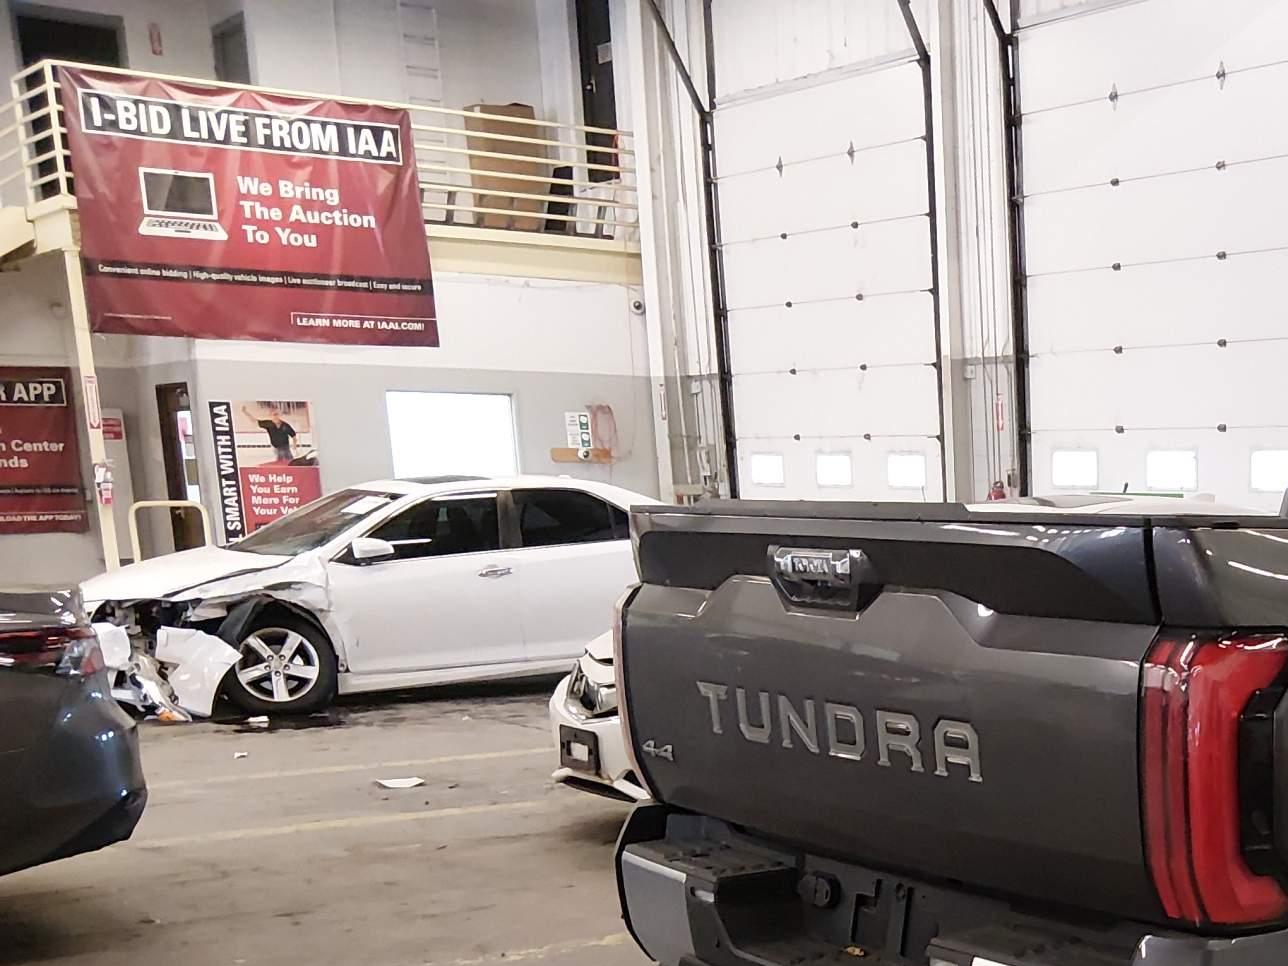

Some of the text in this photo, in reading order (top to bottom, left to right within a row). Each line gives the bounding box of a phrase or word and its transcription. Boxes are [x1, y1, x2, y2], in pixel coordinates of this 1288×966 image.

[90, 97, 397, 158] I-BID LIVE FROM IAA
[236, 175, 340, 206] We Bring
[239, 200, 376, 228] The Auction
[241, 224, 318, 248] To You
[296, 317, 330, 327] LEARN
[332, 319, 361, 328] MORE
[362, 320, 375, 329] AT
[13, 382, 56, 402] APP
[213, 404, 230, 431] IAA
[10, 439, 65, 452] Center
[216, 435, 235, 475] WITH
[248, 473, 293, 484] We Help
[250, 484, 298, 494] You Earn
[221, 478, 242, 531] SMART
[251, 495, 300, 505] More For
[252, 506, 278, 516] Your
[696, 680, 983, 783] TUNDRA
